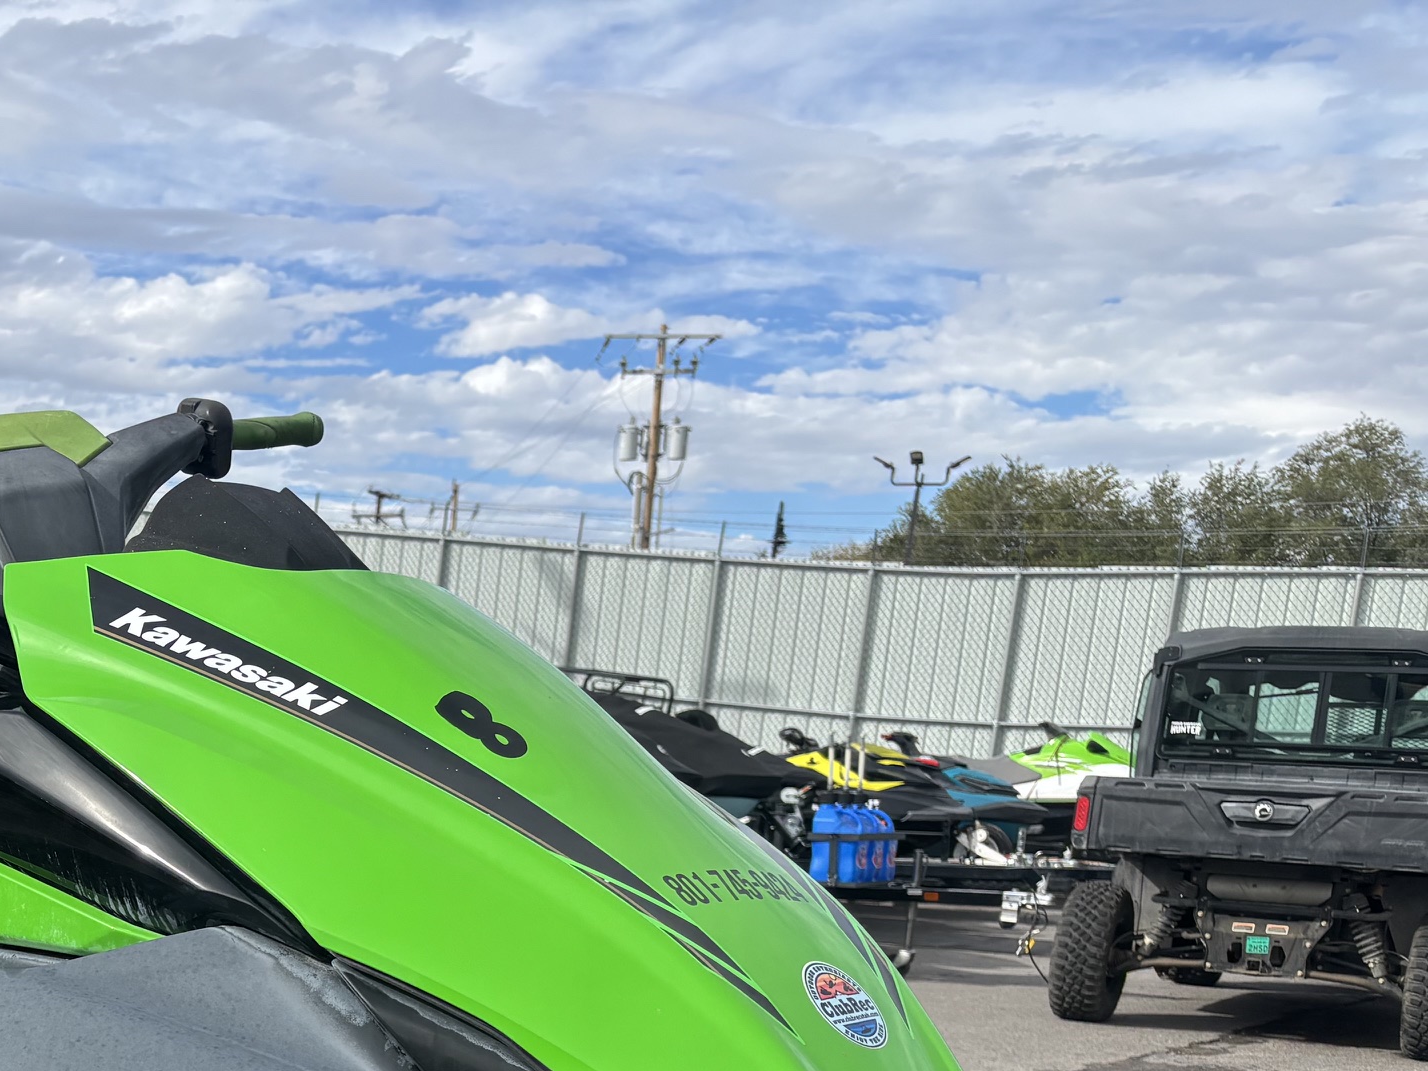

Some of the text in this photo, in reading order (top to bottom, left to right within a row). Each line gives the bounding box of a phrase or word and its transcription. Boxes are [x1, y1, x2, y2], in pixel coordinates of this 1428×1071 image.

[108, 606, 349, 717] Kawasaki
[434, 690, 528, 759] 8
[819, 997, 875, 1018] ClubRec
